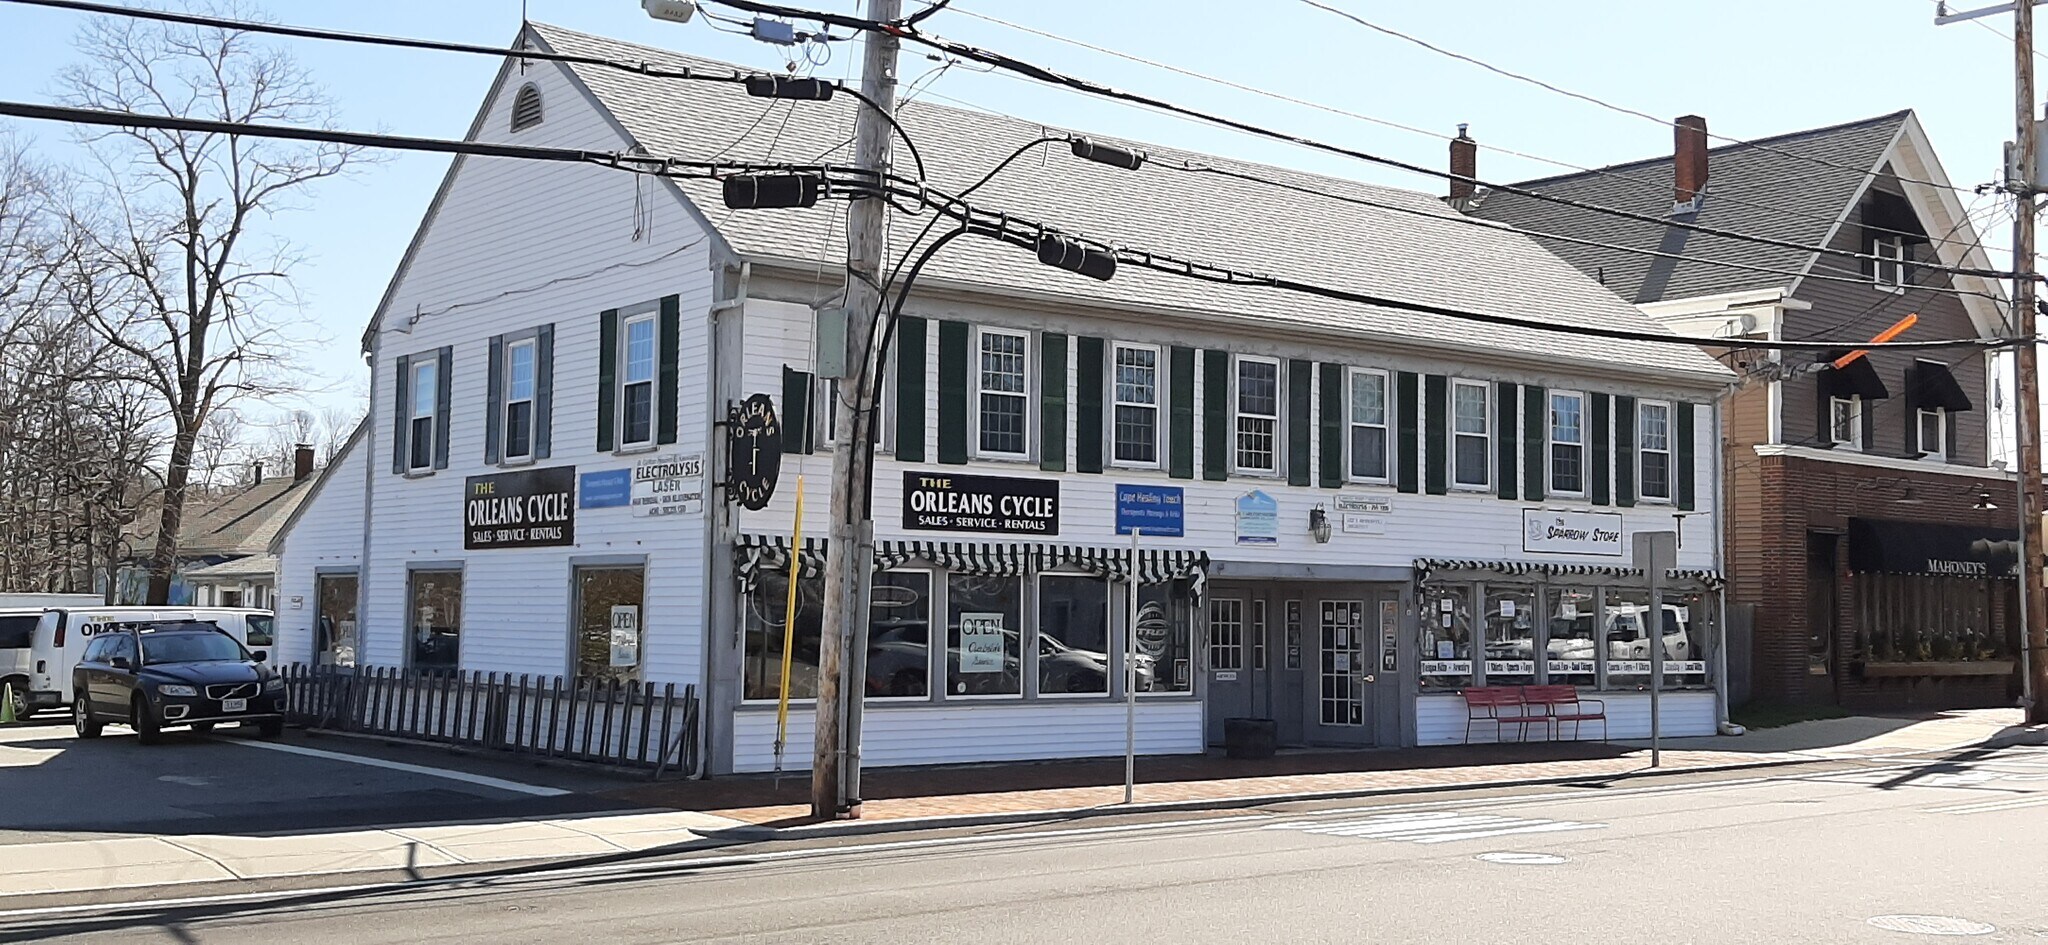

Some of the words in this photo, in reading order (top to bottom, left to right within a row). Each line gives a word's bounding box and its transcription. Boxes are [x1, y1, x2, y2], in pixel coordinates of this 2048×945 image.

[736, 401, 775, 437] ORLEANS
[636, 460, 699, 480] ELECTROLYSIS
[475, 482, 494, 494] THE
[652, 480, 681, 493] LASER
[739, 477, 770, 502] CYCLE
[919, 477, 952, 489] THE
[910, 490, 993, 515] ORLEANS
[1000, 495, 1053, 518] CYCLE
[1120, 491, 1136, 504] Cape
[1163, 493, 1181, 504] Touch
[468, 496, 522, 526] ORLEANS
[527, 493, 568, 522] CYCLE
[918, 515, 948, 526] SALES
[956, 517, 997, 528] SERVICE
[1005, 519, 1046, 530] RENTALS
[473, 530, 492, 543] SALES
[496, 529, 525, 541] SERVICE
[530, 527, 561, 540] RENTALS
[1547, 525, 1590, 541] SPARROW
[1592, 528, 1619, 542] STORE
[1928, 559, 1986, 574] MAHONEY'S
[613, 612, 635, 628] OPEN
[963, 618, 1000, 635] OPEN
